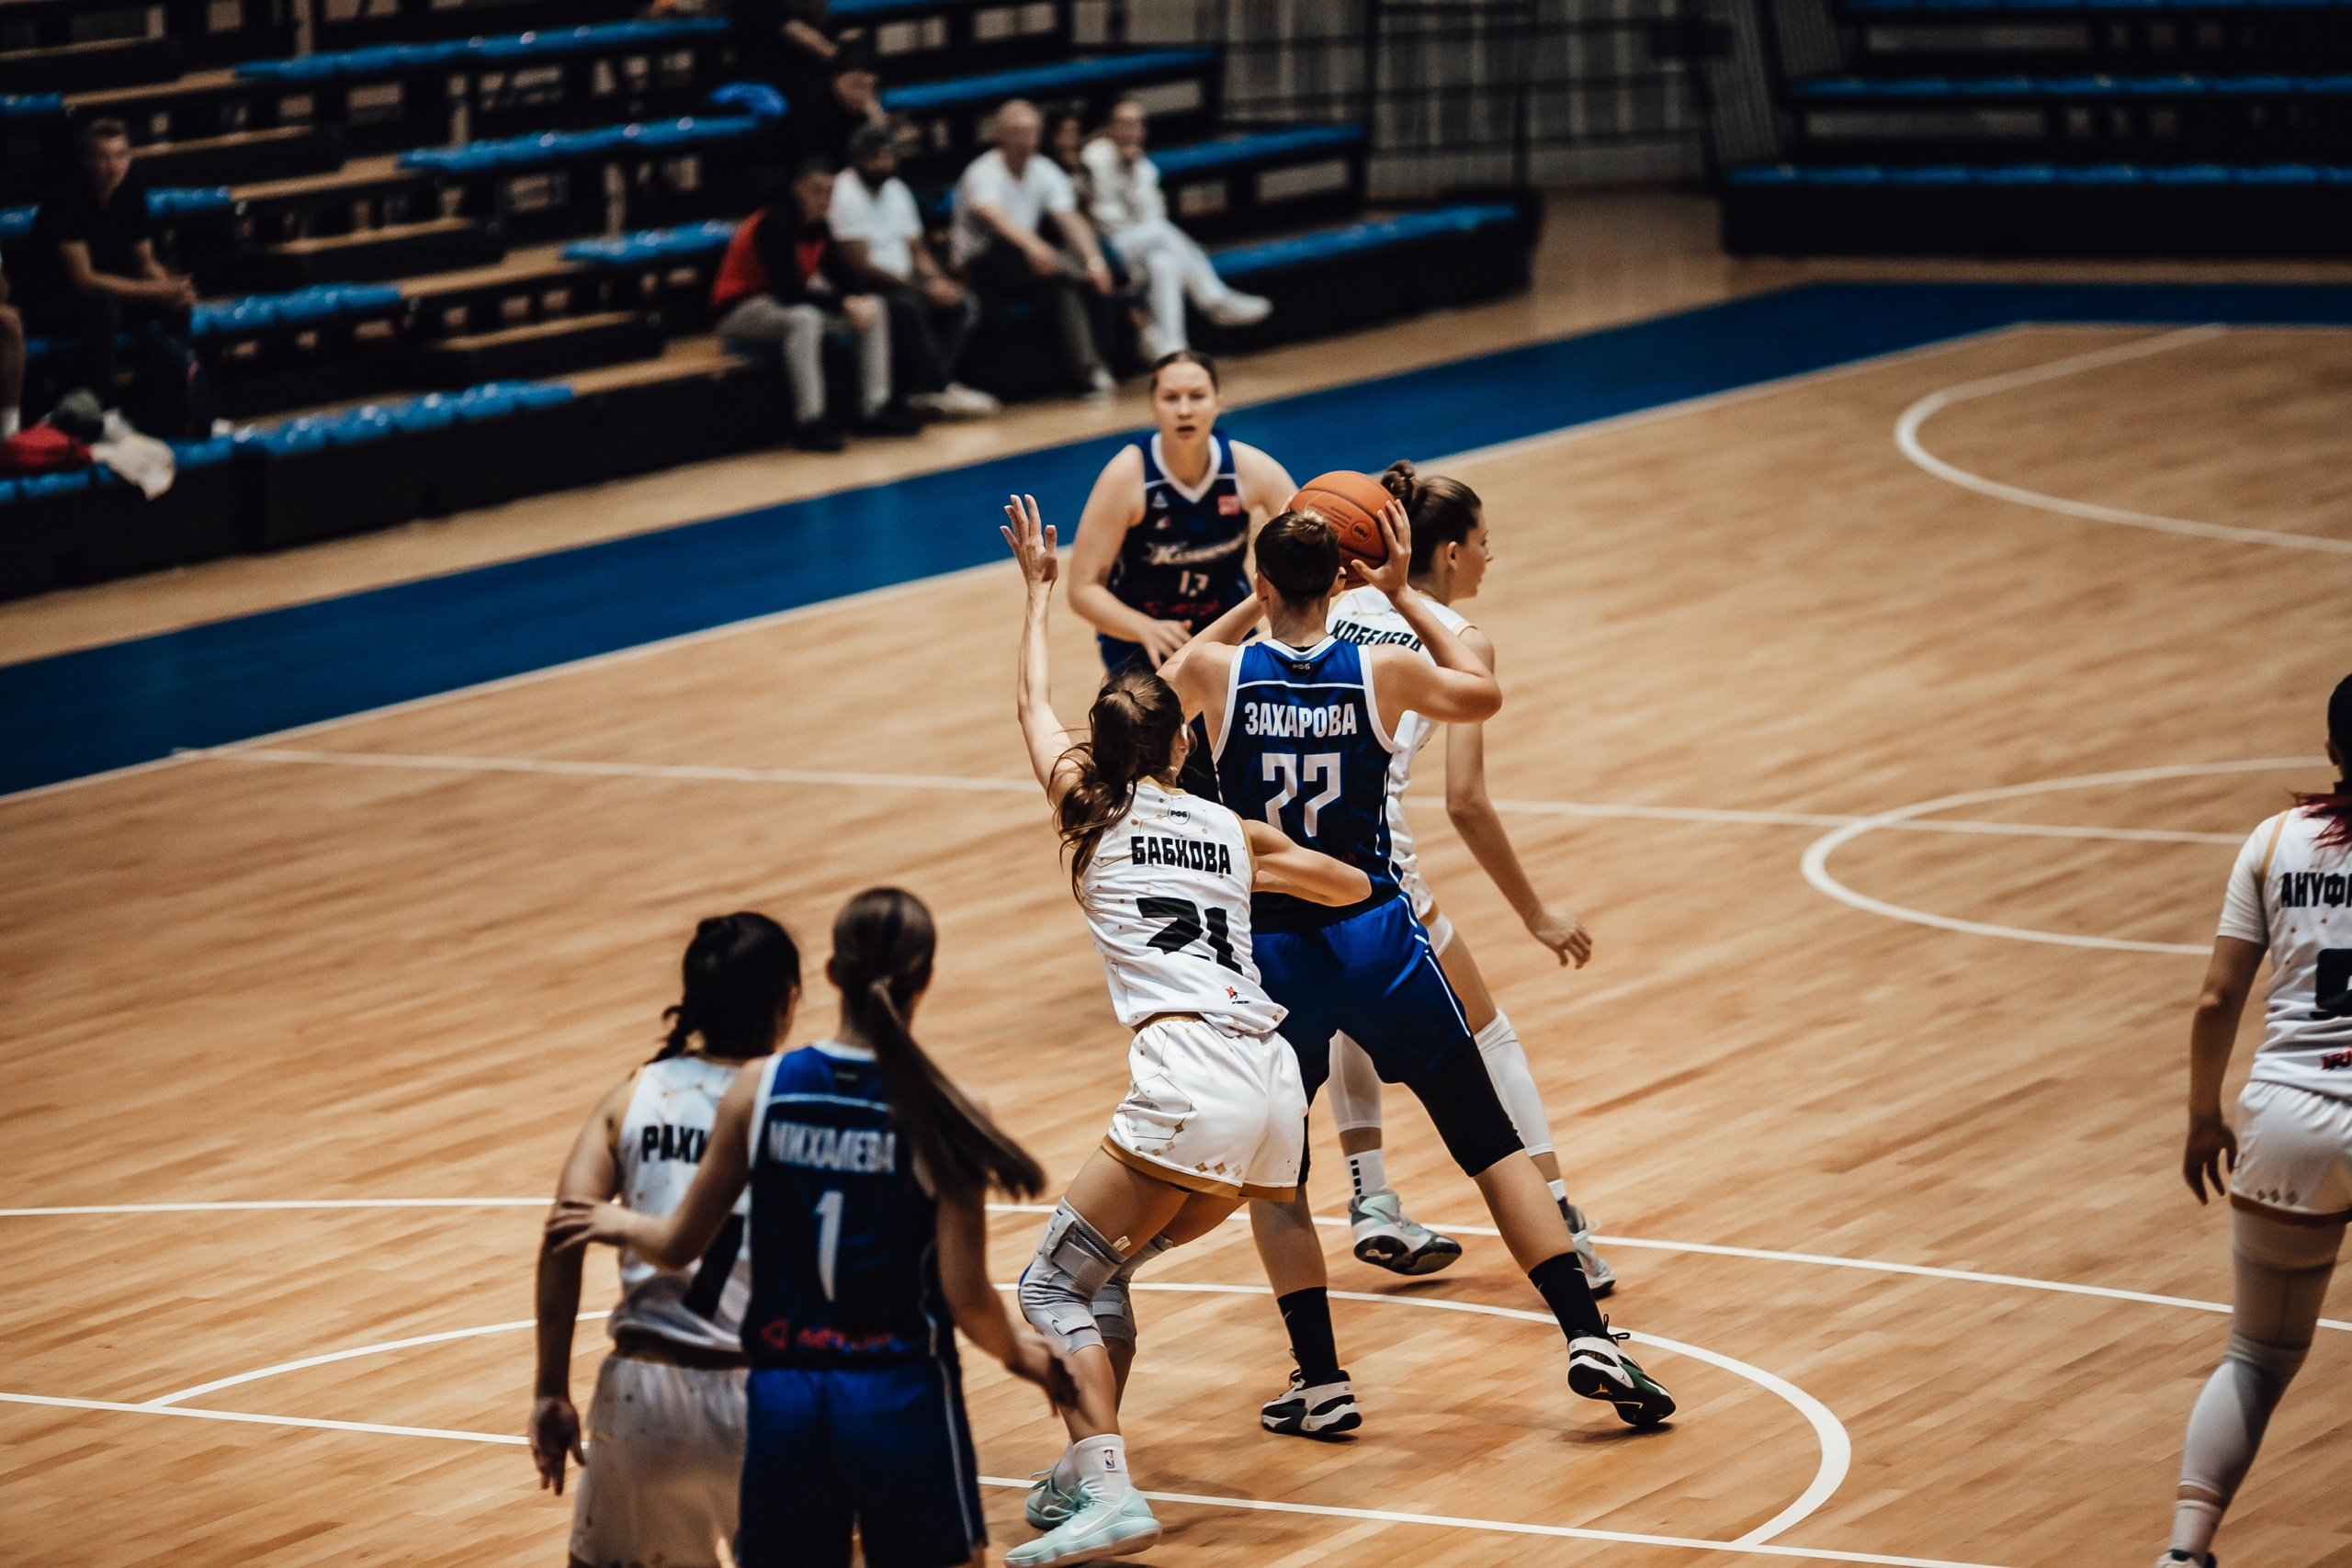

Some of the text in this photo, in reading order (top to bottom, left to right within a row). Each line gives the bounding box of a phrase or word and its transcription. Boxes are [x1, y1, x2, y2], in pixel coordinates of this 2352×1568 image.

[1244, 702, 1357, 738] ЗАХАРОВА
[1170, 809, 1188, 818] РФБ
[1131, 836, 1232, 875] БАБКОВА
[2280, 872, 2352, 908] АНУФ
[1136, 897, 1244, 976] 21
[813, 1190, 844, 1303] 1
